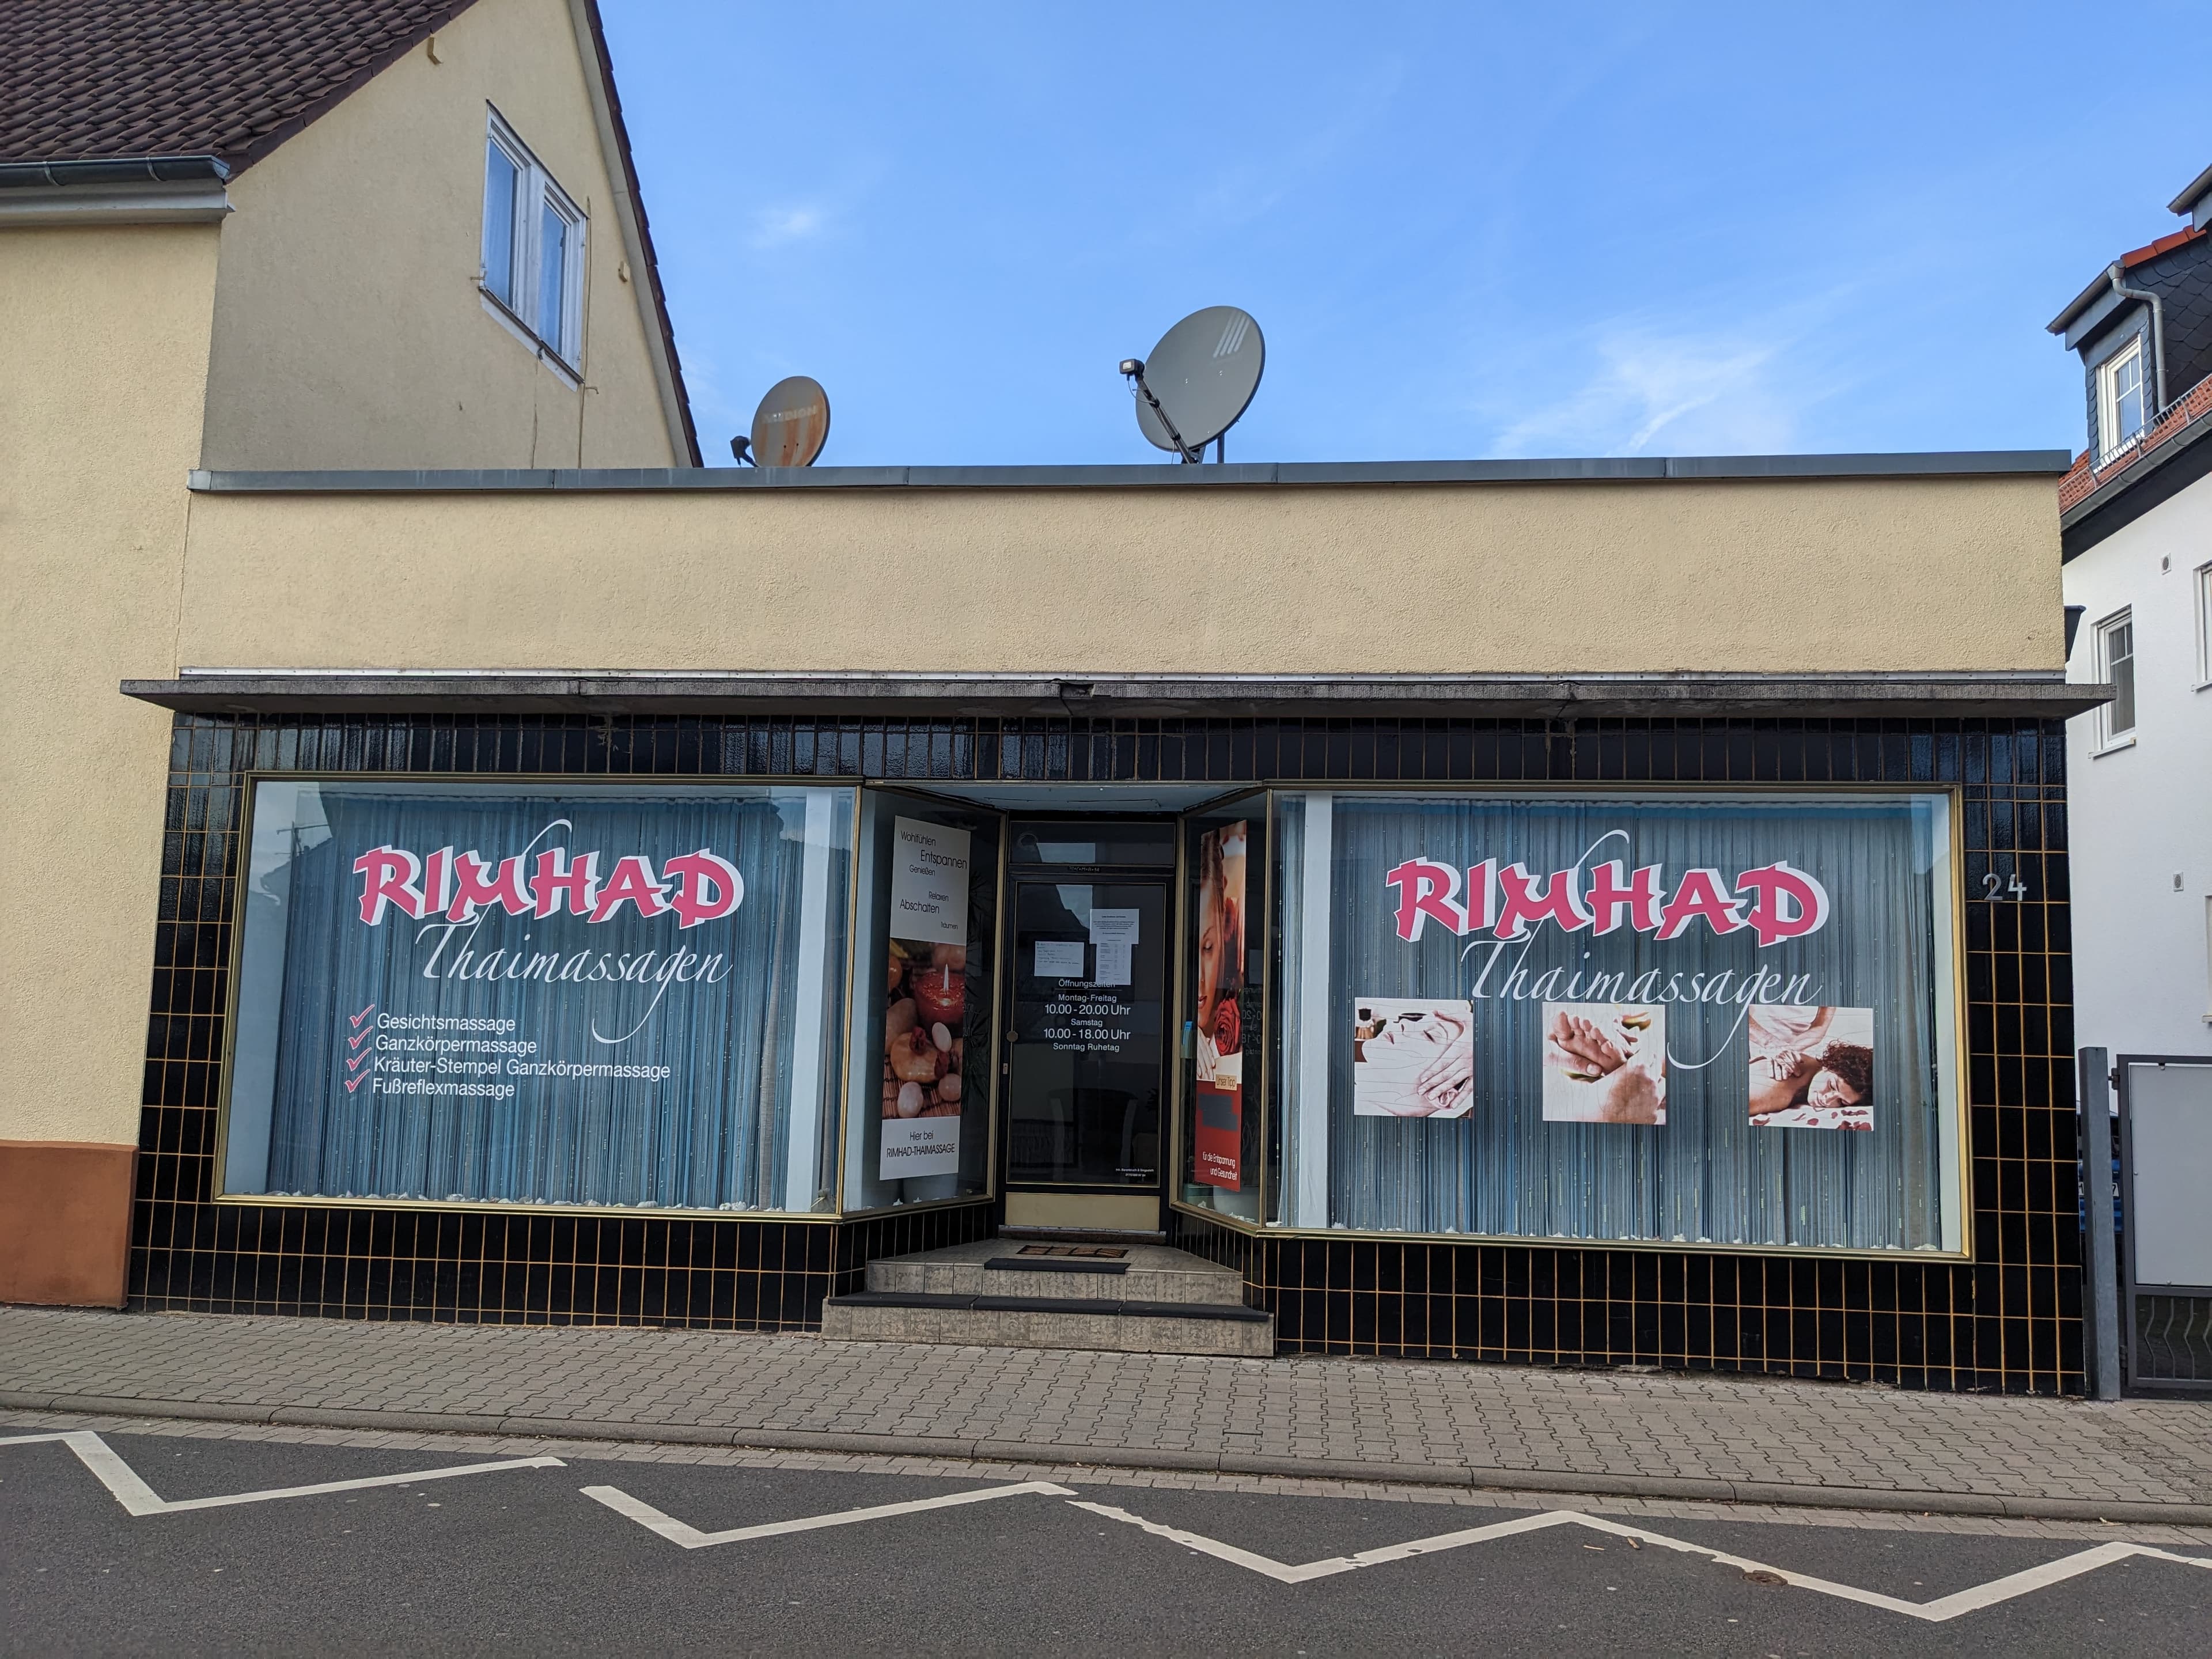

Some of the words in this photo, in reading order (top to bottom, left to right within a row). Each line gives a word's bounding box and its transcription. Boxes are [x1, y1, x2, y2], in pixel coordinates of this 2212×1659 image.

[900, 830, 936, 847] Wohlfühlen
[921, 849, 967, 869] Entspannen
[909, 865, 935, 876] Genießen
[353, 844, 744, 929] RIMHAD
[1982, 873, 2027, 901] 24
[929, 891, 949, 902] Relaxen
[1386, 856, 1830, 948] RIMHAD
[899, 899, 940, 914] Abschalten
[1058, 978, 1115, 988] Öffnungszeiten
[1044, 1004, 1071, 1014] 10.00
[1078, 1005, 1108, 1014] 20.00
[1111, 1005, 1131, 1015] Uhr
[377, 1013, 516, 1035] Gesichtsmassage
[1070, 1018, 1103, 1028] Samstag
[1043, 1028, 1071, 1038] 10.00
[1078, 1029, 1108, 1039] 18.00
[1111, 1029, 1131, 1040] Uhr
[376, 1034, 537, 1056] Ganzkörpermassage
[1053, 1043, 1085, 1052] Sonntag
[1088, 1043, 1120, 1052] Ruhetag
[374, 1056, 501, 1078] Kräuter-Stempel
[506, 1059, 671, 1082] Ganzkörpermassage
[373, 1078, 515, 1100] Fußreflexmassage
[910, 1131, 922, 1141] Hier
[923, 1130, 934, 1140] bei
[886, 1143, 955, 1158] RIMHAD-THAIMASSAGE
[1213, 1153, 1236, 1169] Entspannung
[1217, 1168, 1238, 1181] Gesundheit
